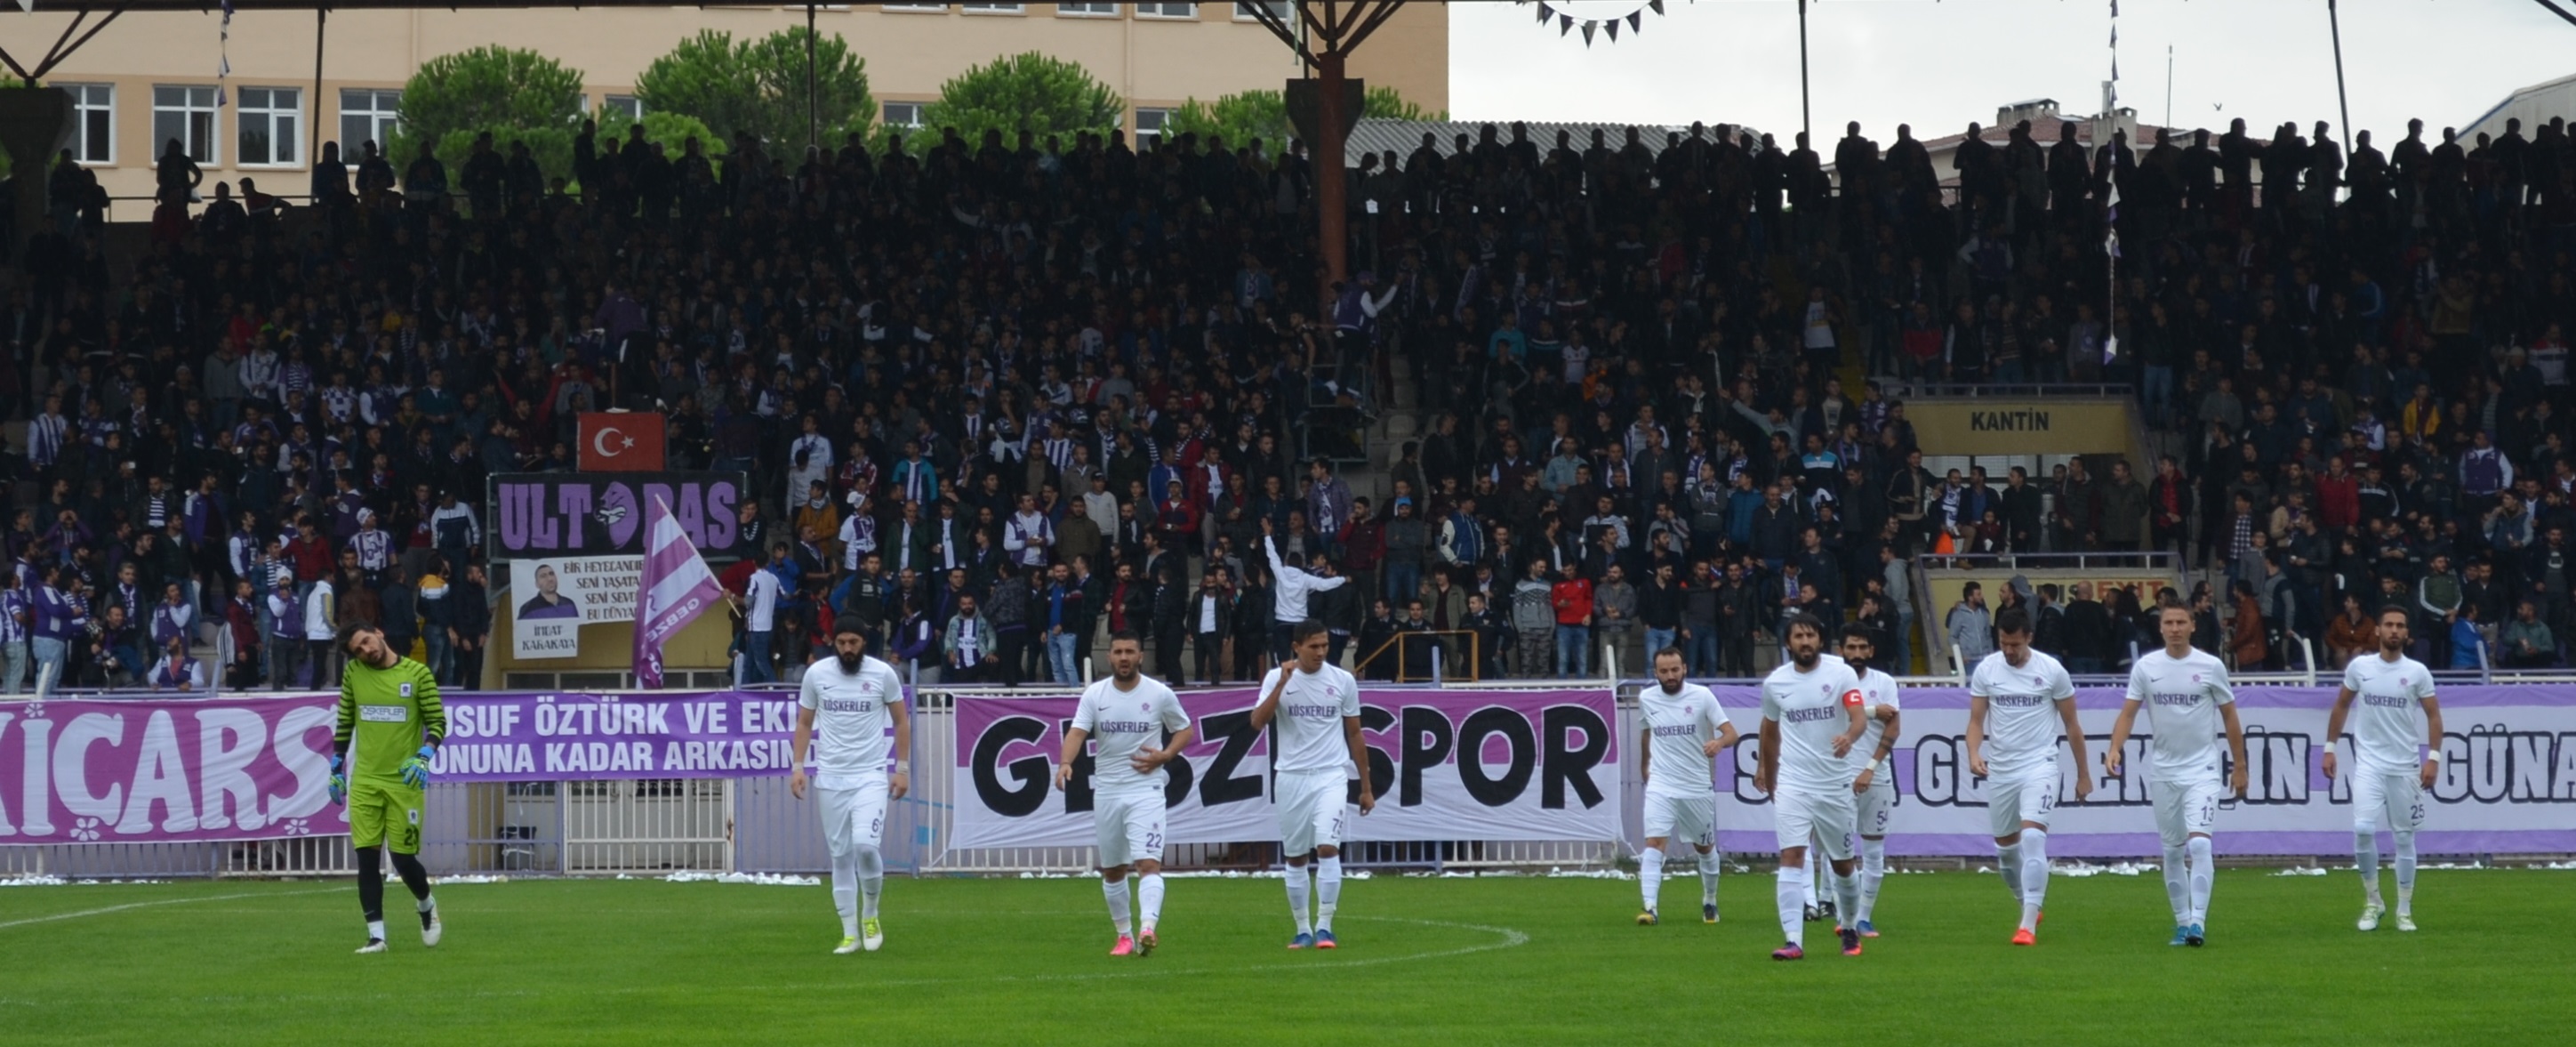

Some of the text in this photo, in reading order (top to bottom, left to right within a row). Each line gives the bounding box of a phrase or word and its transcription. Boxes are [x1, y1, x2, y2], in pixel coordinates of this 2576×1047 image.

[1970, 407, 2050, 431] KANTİN
[576, 576, 600, 589] SENİ
[585, 592, 608, 605] SENİ
[587, 608, 601, 621] BU
[535, 695, 670, 737] ÖZTÜRK
[683, 701, 728, 736] VE
[544, 741, 654, 773] KADAR
[2041, 793, 2053, 810] 12
[2201, 805, 2214, 822] 13
[2410, 803, 2426, 820] 25
[1145, 832, 1163, 848] 22
